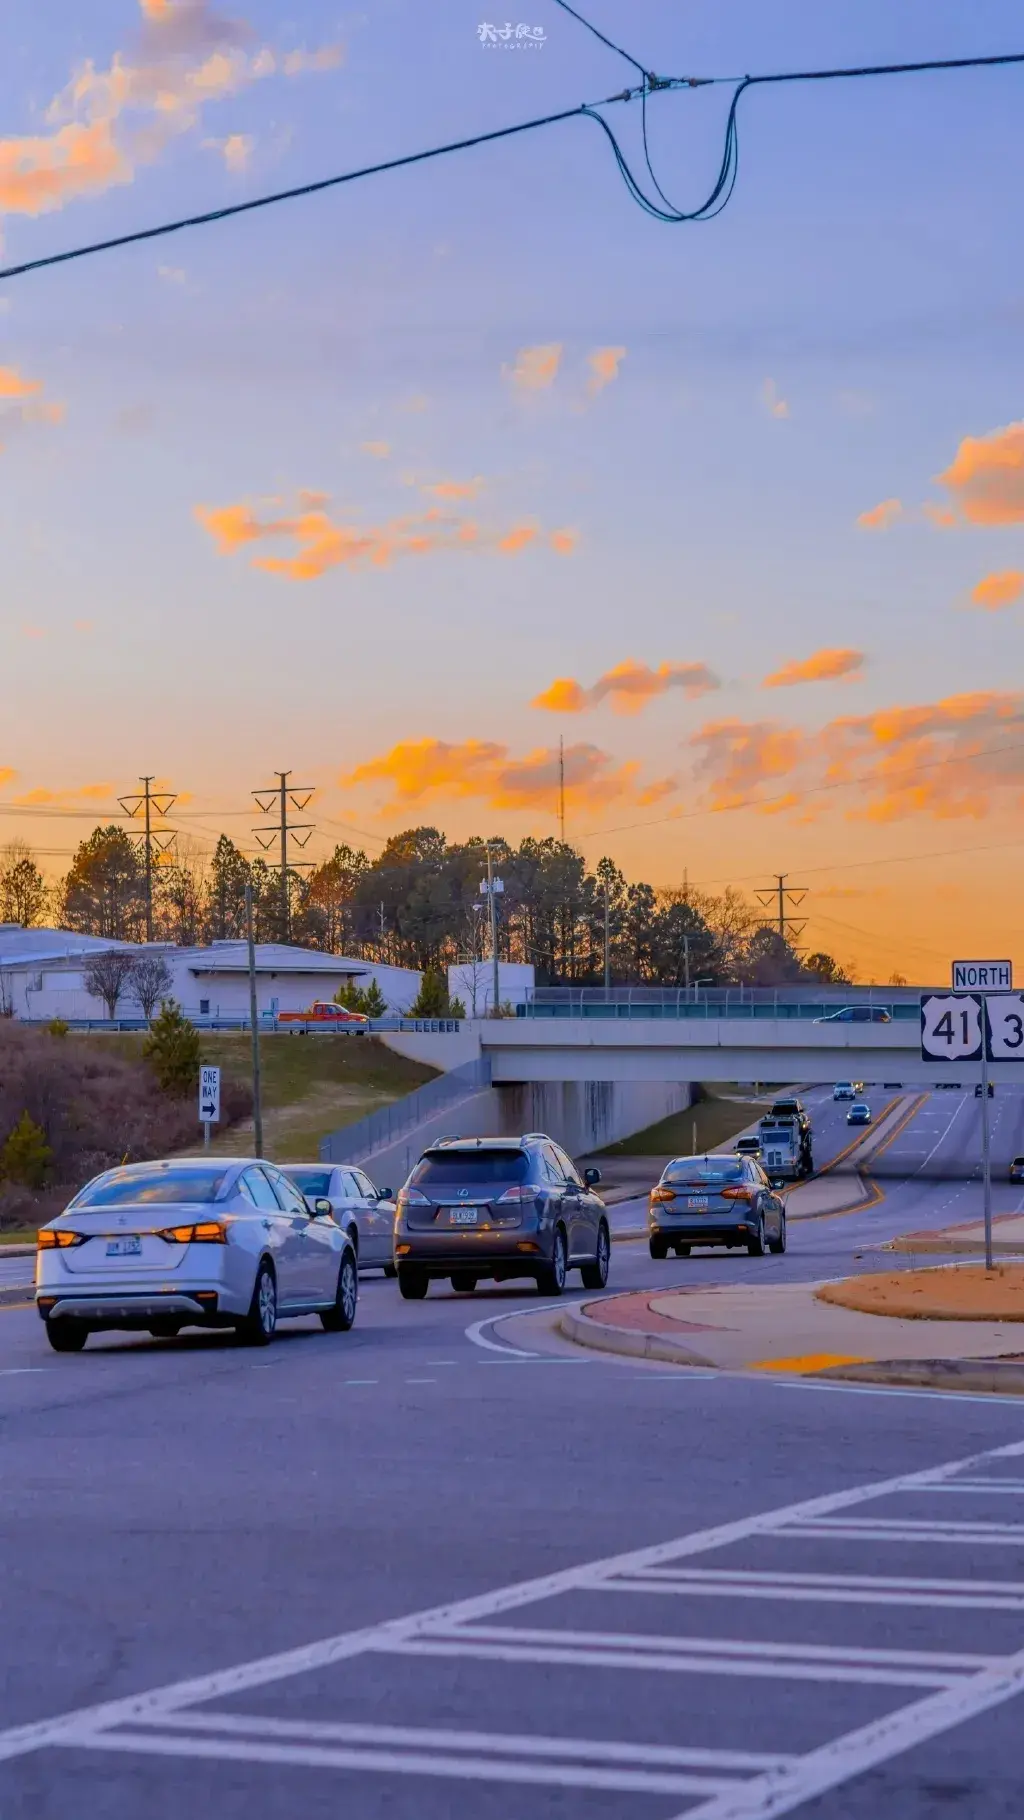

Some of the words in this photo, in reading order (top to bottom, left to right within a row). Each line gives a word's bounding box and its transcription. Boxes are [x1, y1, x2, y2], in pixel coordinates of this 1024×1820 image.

[955, 967, 1009, 986] NORTH
[932, 1011, 968, 1045] 41
[1003, 1014, 1023, 1048] 3
[203, 1071, 217, 1083] ONE
[202, 1086, 217, 1098] WAY
